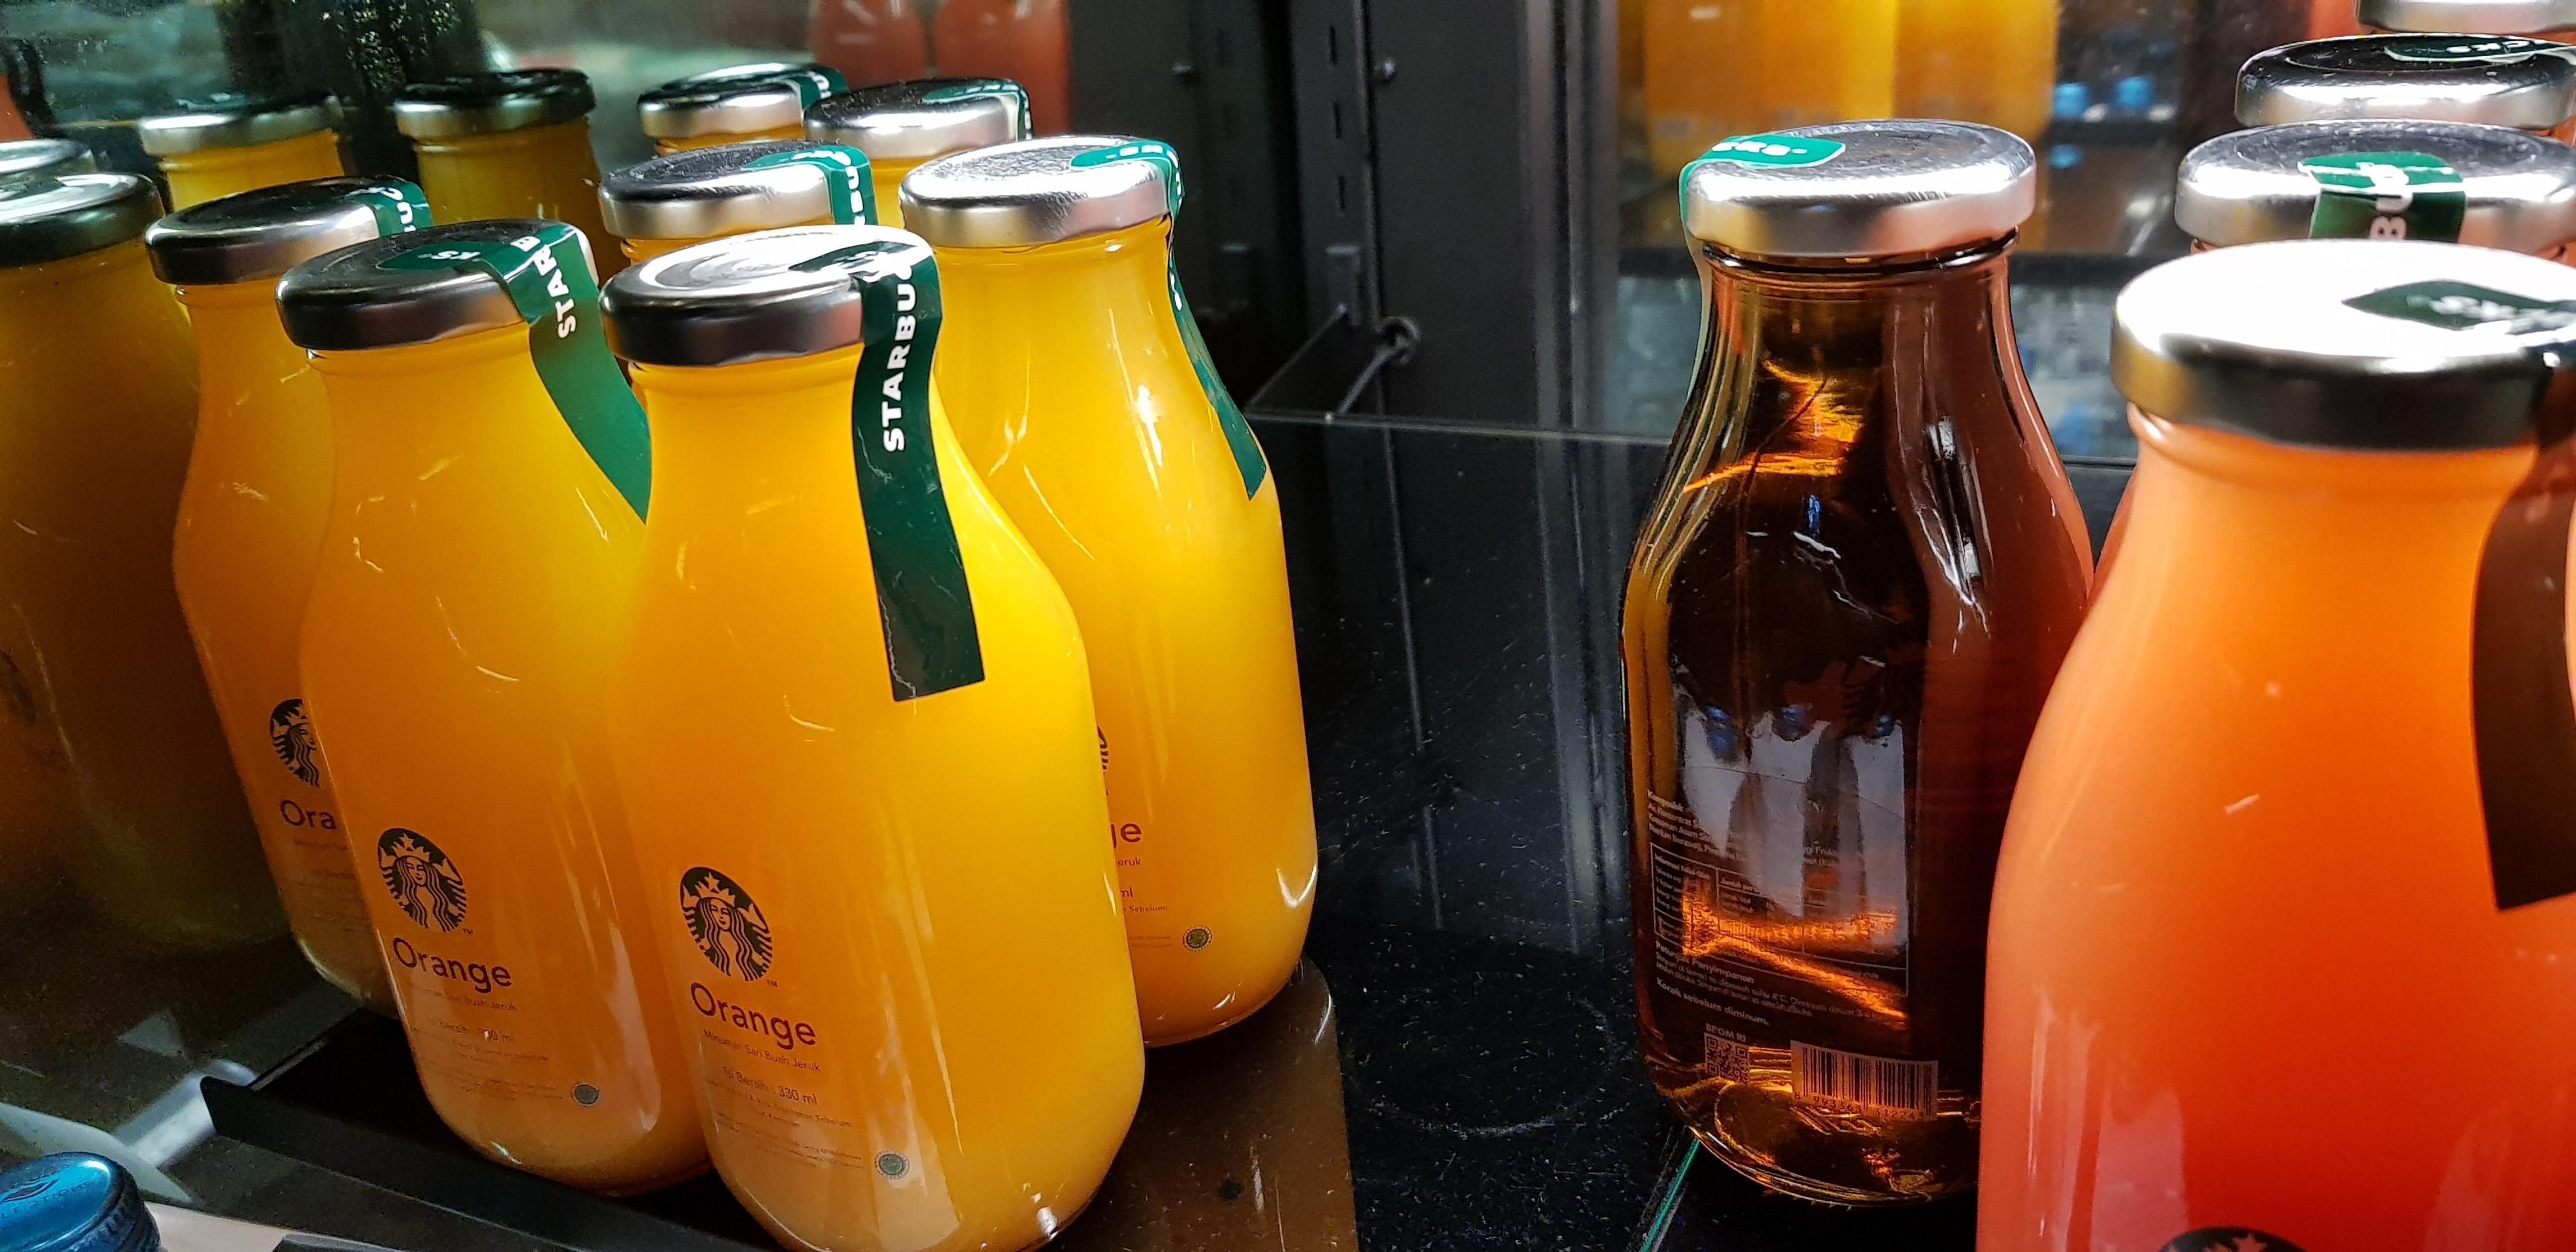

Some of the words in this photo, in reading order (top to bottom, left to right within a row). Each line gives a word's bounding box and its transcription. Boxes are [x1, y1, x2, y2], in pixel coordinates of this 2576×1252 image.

[280, 800, 337, 830] Ora
[1118, 857, 1142, 867] eruk
[393, 937, 512, 994] Orange
[691, 981, 817, 1050] Orange
